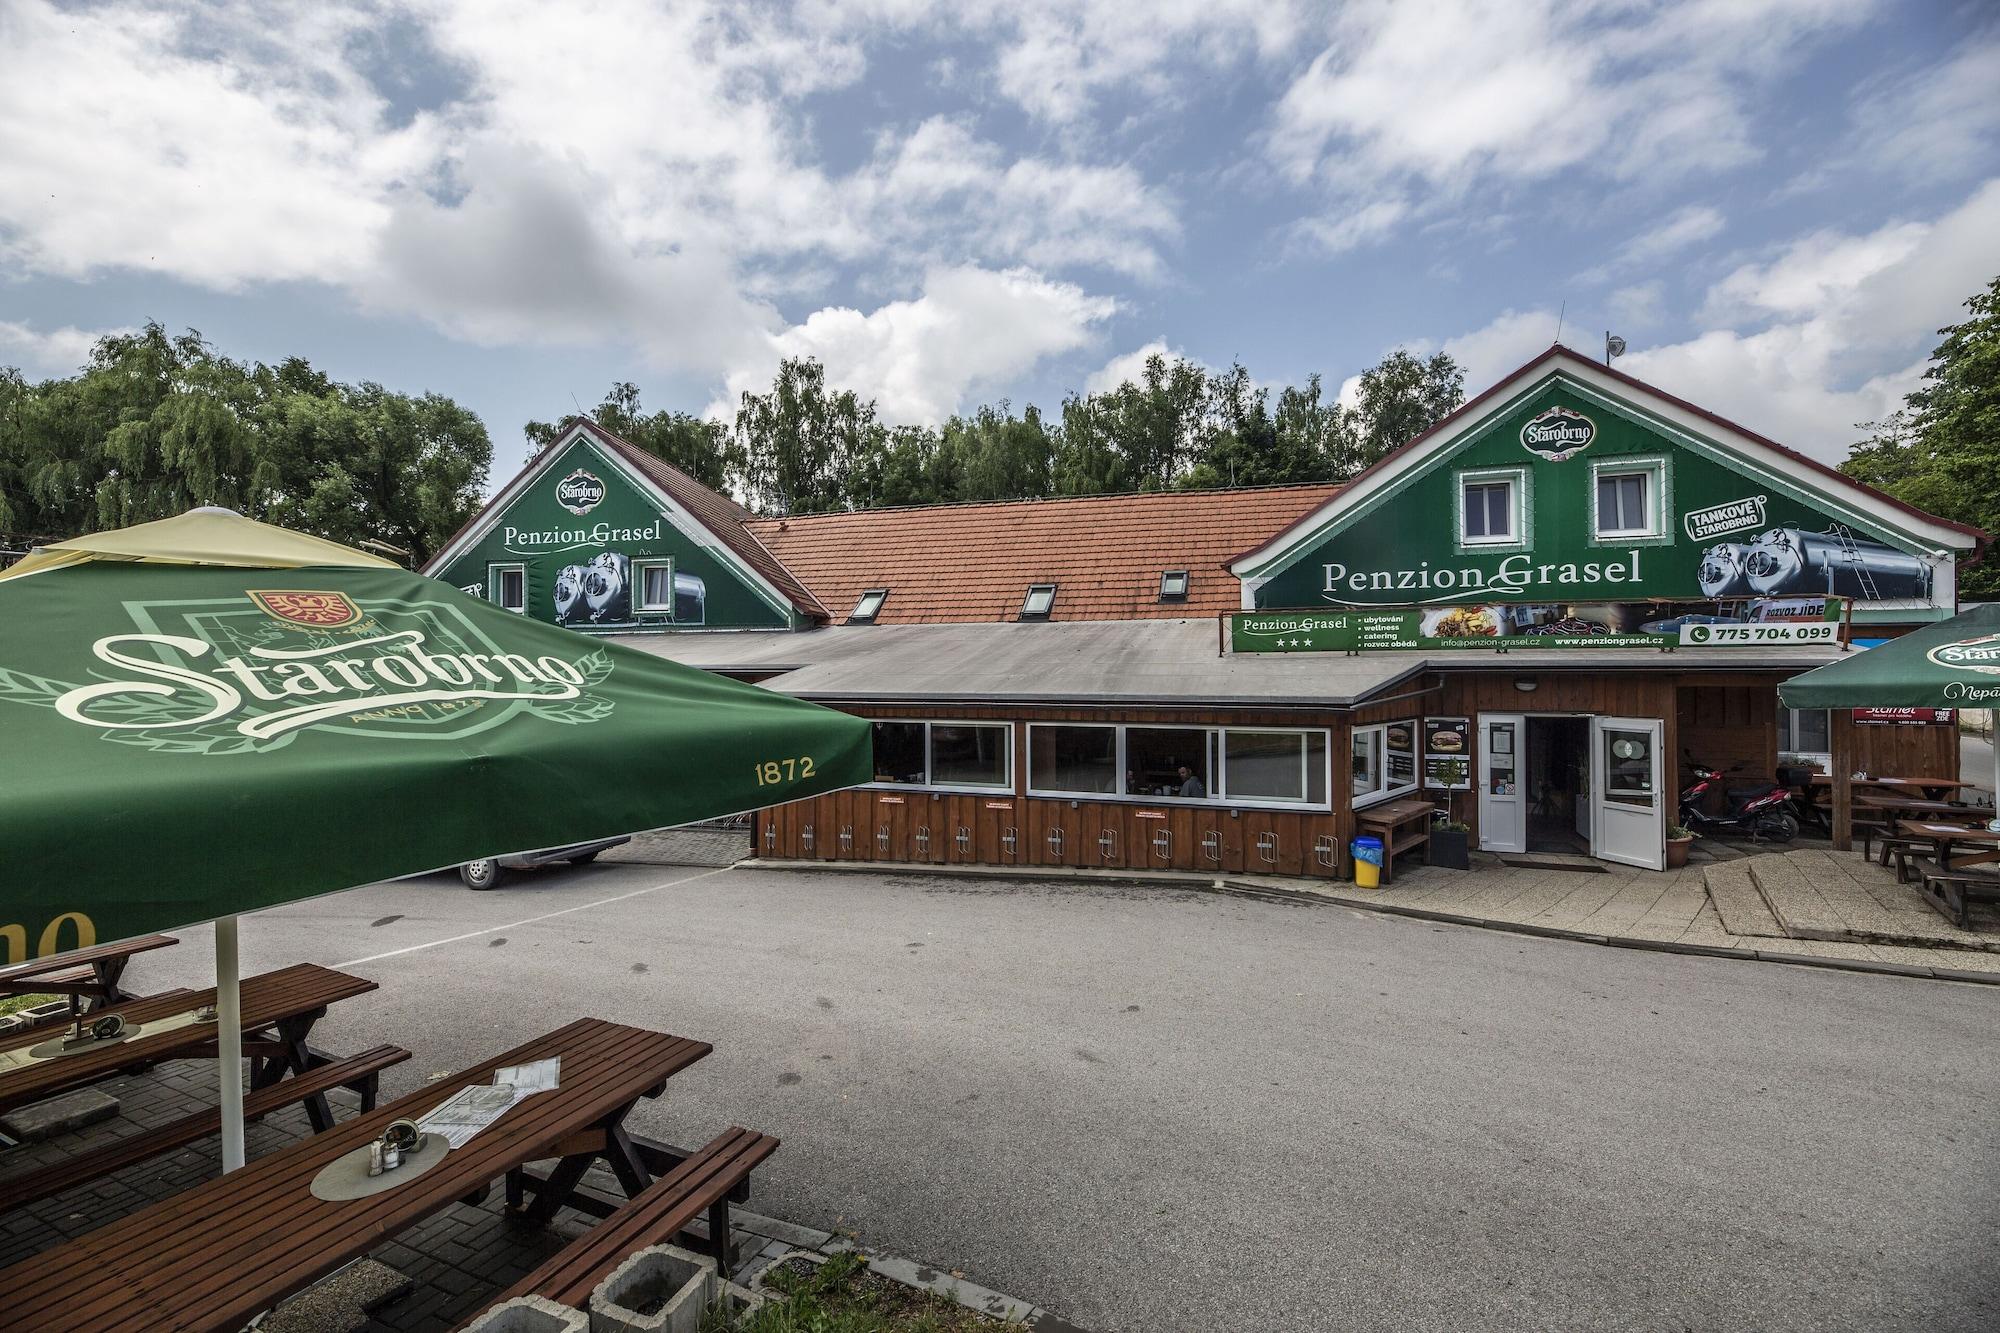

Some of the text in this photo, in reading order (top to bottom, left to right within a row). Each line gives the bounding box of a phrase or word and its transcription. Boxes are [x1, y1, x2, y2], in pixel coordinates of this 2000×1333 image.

[1528, 421, 1590, 447] Starobrno
[561, 481, 602, 503] Starobrno
[1691, 500, 1756, 526] TANKOVÉ
[504, 519, 661, 547] Penzion Grasel
[1696, 514, 1759, 537] STAROBRNO
[1322, 550, 1643, 594] Penzion Grasel
[1243, 617, 1348, 632] Penzion Grasel
[1715, 627, 1831, 640] 775 704 099
[1363, 632, 1398, 641] catering
[1441, 638, 1541, 648] info@penzion-grasel.cz
[1554, 636, 1664, 646] www.penziongrasel.cz
[55, 630, 585, 740] Starobrno
[755, 756, 816, 786] 1872
